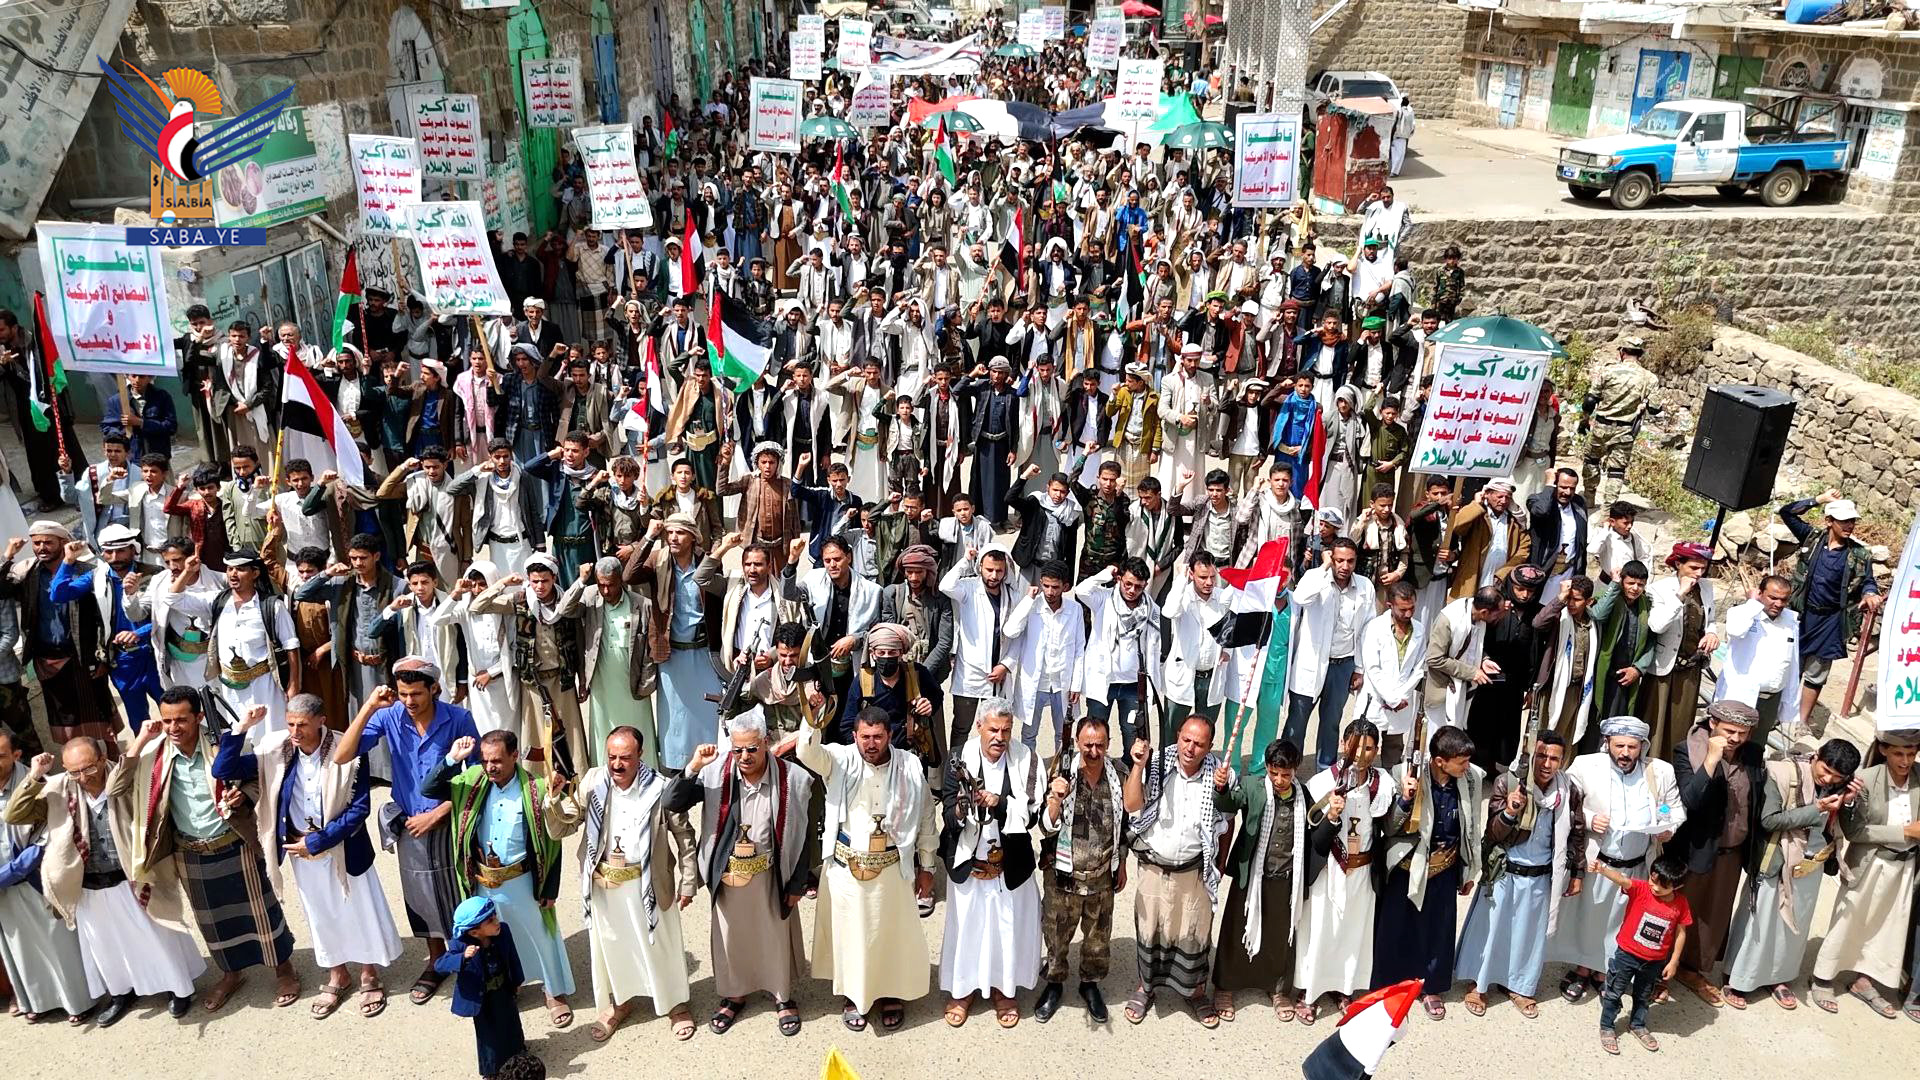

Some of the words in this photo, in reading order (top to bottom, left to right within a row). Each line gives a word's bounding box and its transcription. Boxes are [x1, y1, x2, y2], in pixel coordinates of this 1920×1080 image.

[529, 61, 553, 78] أكبر
[555, 63, 571, 74] الله
[417, 96, 448, 116] أكبر
[451, 99, 470, 113] الله
[450, 120, 471, 130] الموت
[452, 135, 474, 144] الموت
[585, 134, 616, 158] أكبر
[1244, 128, 1292, 147] قاطعوا
[359, 141, 388, 162] أكبر
[391, 144, 411, 159] الله
[1244, 148, 1269, 165] الأمريكية
[1269, 148, 1291, 163] البضائع
[425, 160, 451, 176] للإسلام
[455, 161, 477, 176] النصر
[416, 207, 446, 233] أكبر
[451, 210, 472, 228] الله
[60, 249, 145, 276] قاطعوا
[66, 280, 110, 305] الأمريكية
[112, 283, 150, 305] البضائع
[74, 332, 158, 354] الإسرائيلية
[1443, 354, 1505, 381] أكبر
[1502, 359, 1538, 381] الله
[1439, 383, 1488, 402] لأمريكا
[1490, 390, 1530, 405] الموت
[1434, 405, 1482, 425] لإسرائيل
[1483, 410, 1523, 426] الموت
[1428, 427, 1462, 443] اليهود
[1463, 429, 1482, 444] على
[1487, 429, 1517, 445] اللعنة
[1421, 447, 1467, 471] للإسلام
[1467, 450, 1511, 471] النصر
